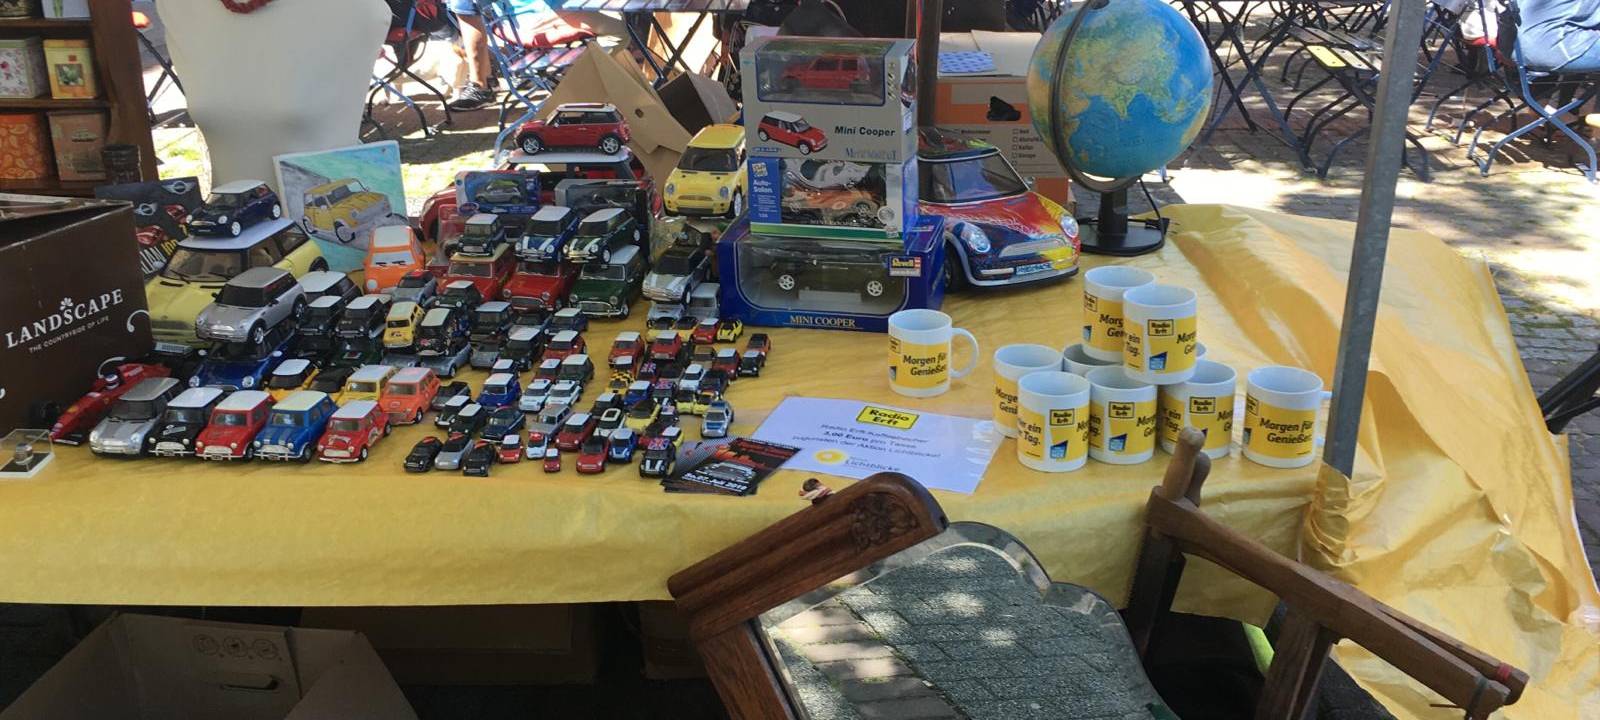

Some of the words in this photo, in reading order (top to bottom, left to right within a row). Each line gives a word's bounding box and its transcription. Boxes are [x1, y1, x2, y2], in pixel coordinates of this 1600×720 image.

[834, 125, 856, 135] Mini
[859, 126, 896, 139] Cooper
[5, 288, 124, 349] LANDSCAPE
[789, 314, 813, 325] MINI
[814, 316, 857, 328] COOPER
[1099, 313, 1124, 328] Morg
[903, 354, 936, 367] Morgen
[910, 364, 947, 376] Genieße
[995, 386, 1018, 404] Morge
[999, 401, 1018, 415] Geni
[869, 409, 910, 423] Radio
[872, 416, 900, 426] Erft
[1259, 417, 1299, 433] Morgen
